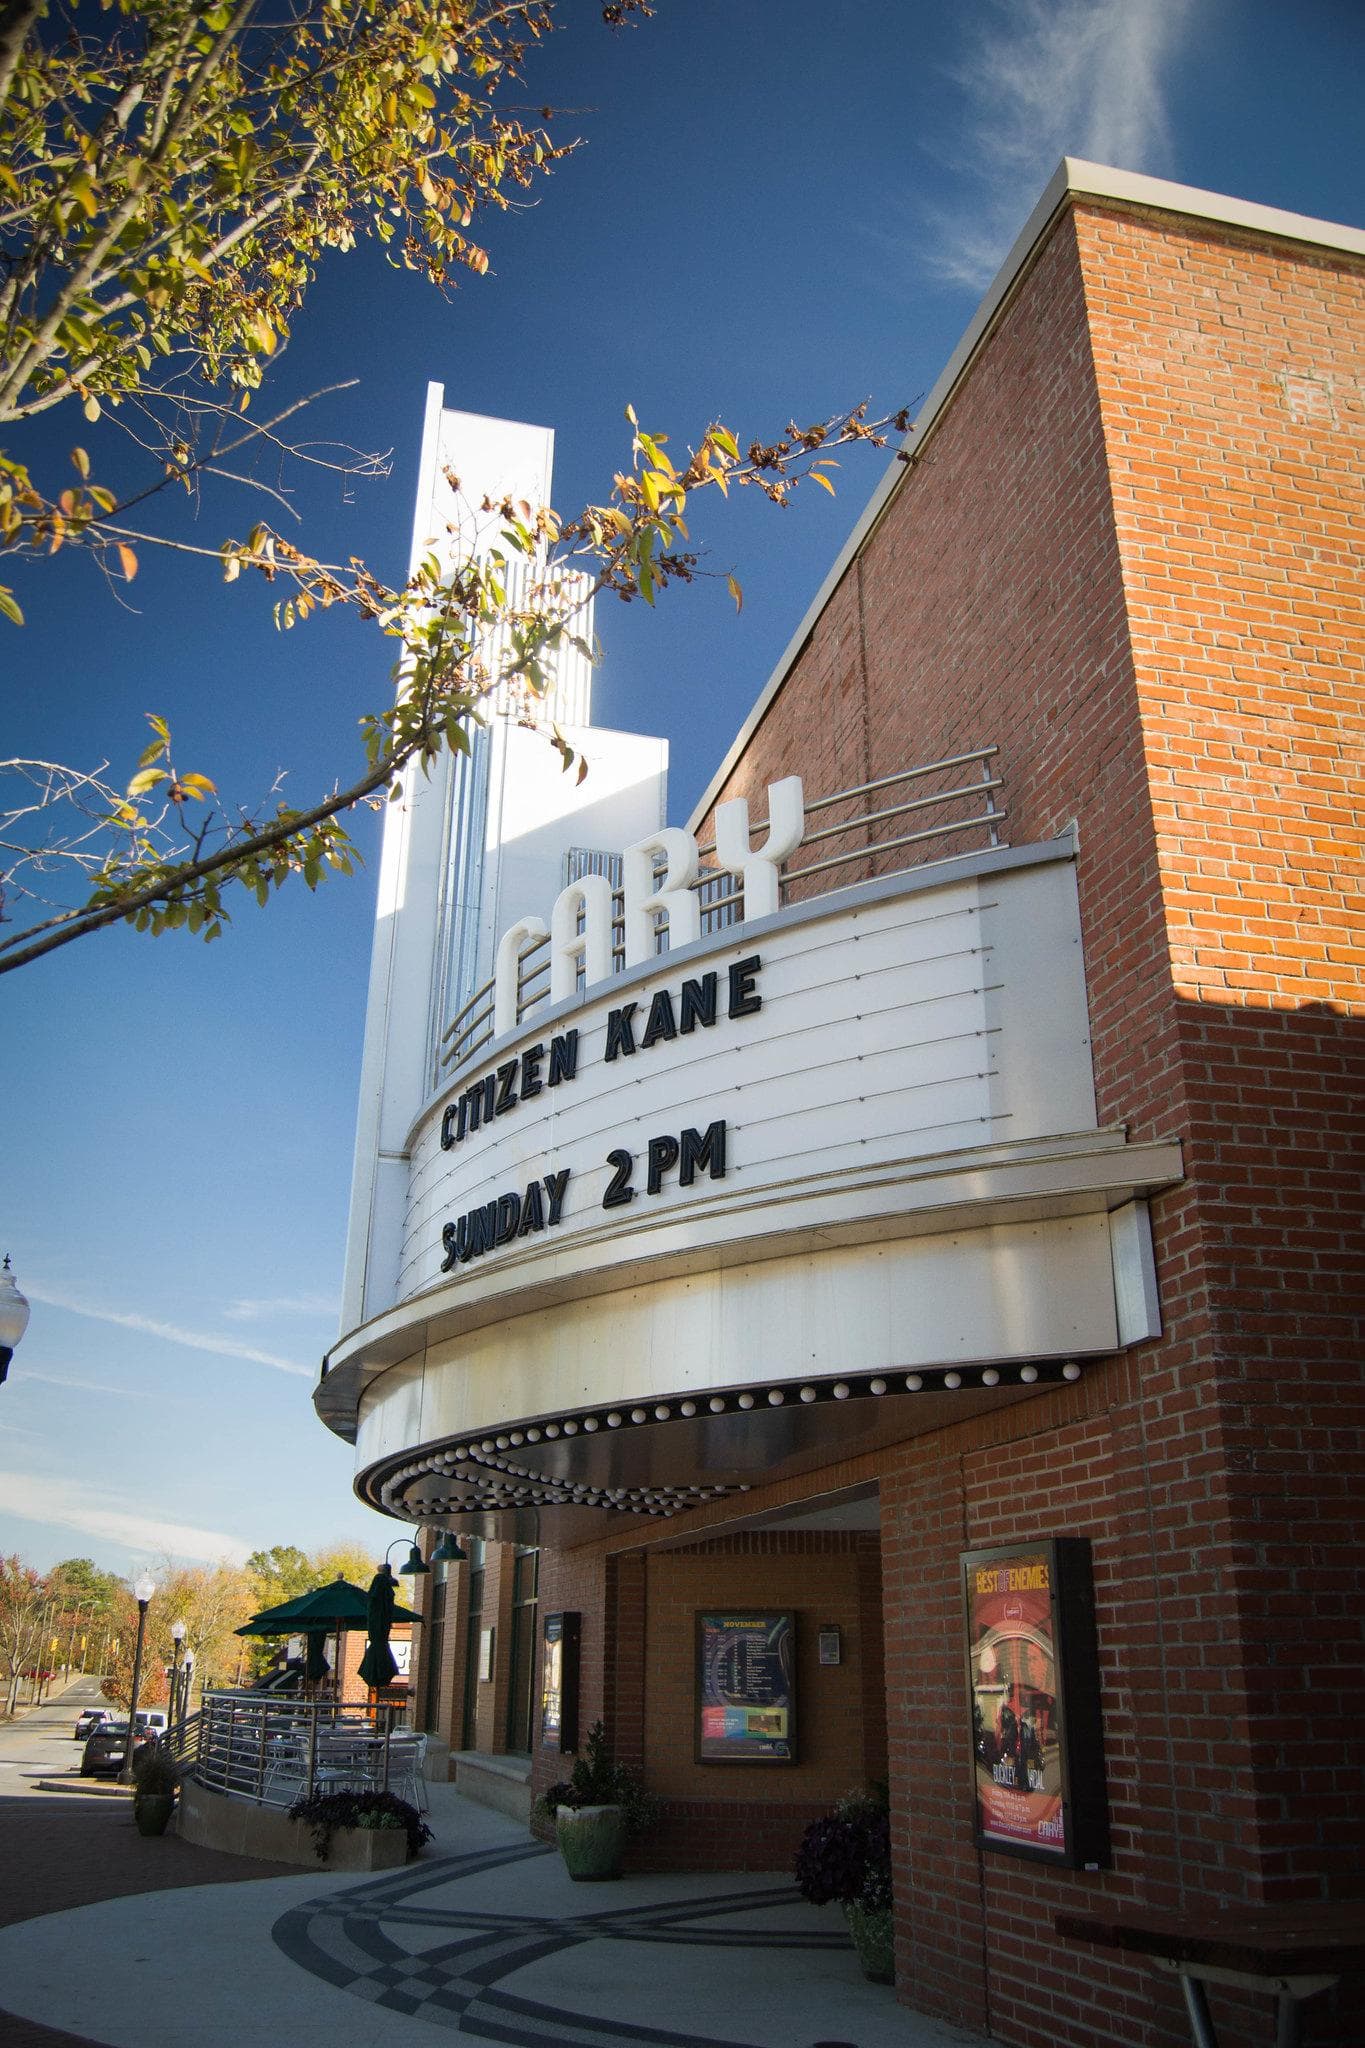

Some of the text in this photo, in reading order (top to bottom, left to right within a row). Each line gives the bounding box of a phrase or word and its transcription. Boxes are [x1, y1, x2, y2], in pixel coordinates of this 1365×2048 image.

[494, 775, 805, 1040] CARY
[440, 954, 762, 1151] CITIZEN KANE
[440, 1168, 571, 1273] SUNDAY
[976, 1570, 998, 1593] BEST
